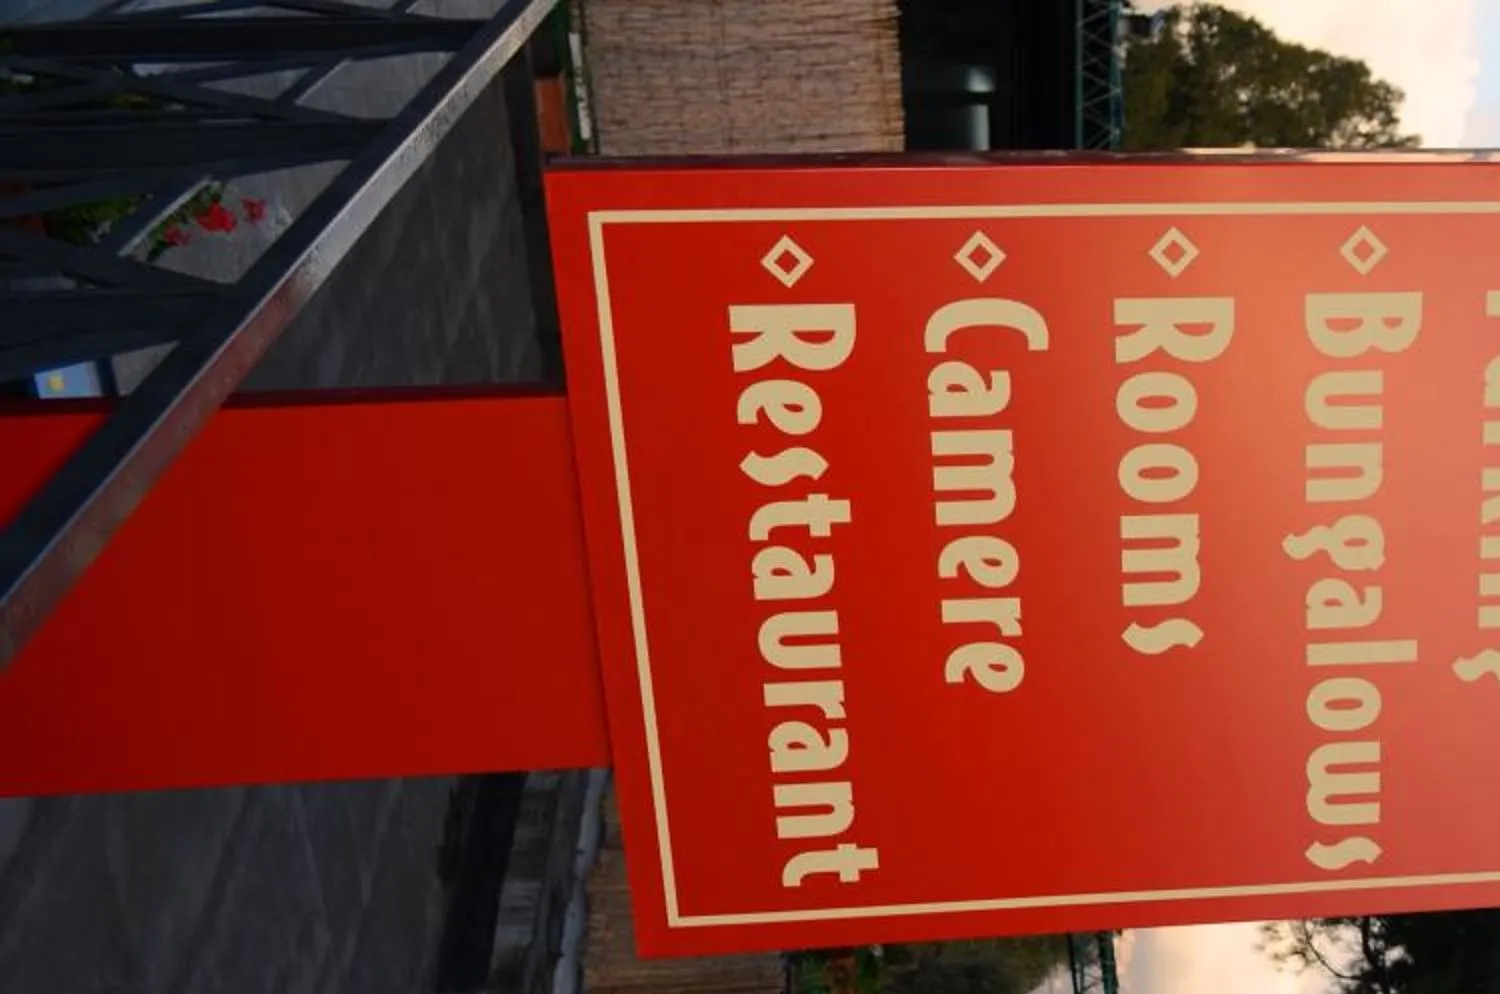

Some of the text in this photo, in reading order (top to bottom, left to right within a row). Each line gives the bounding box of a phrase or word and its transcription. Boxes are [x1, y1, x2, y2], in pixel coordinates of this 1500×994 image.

[727, 303, 879, 889] Restaurant
[922, 298, 1049, 693] Camere
[1112, 297, 1235, 655] Rooms
[1281, 291, 1422, 871] Bungalows
